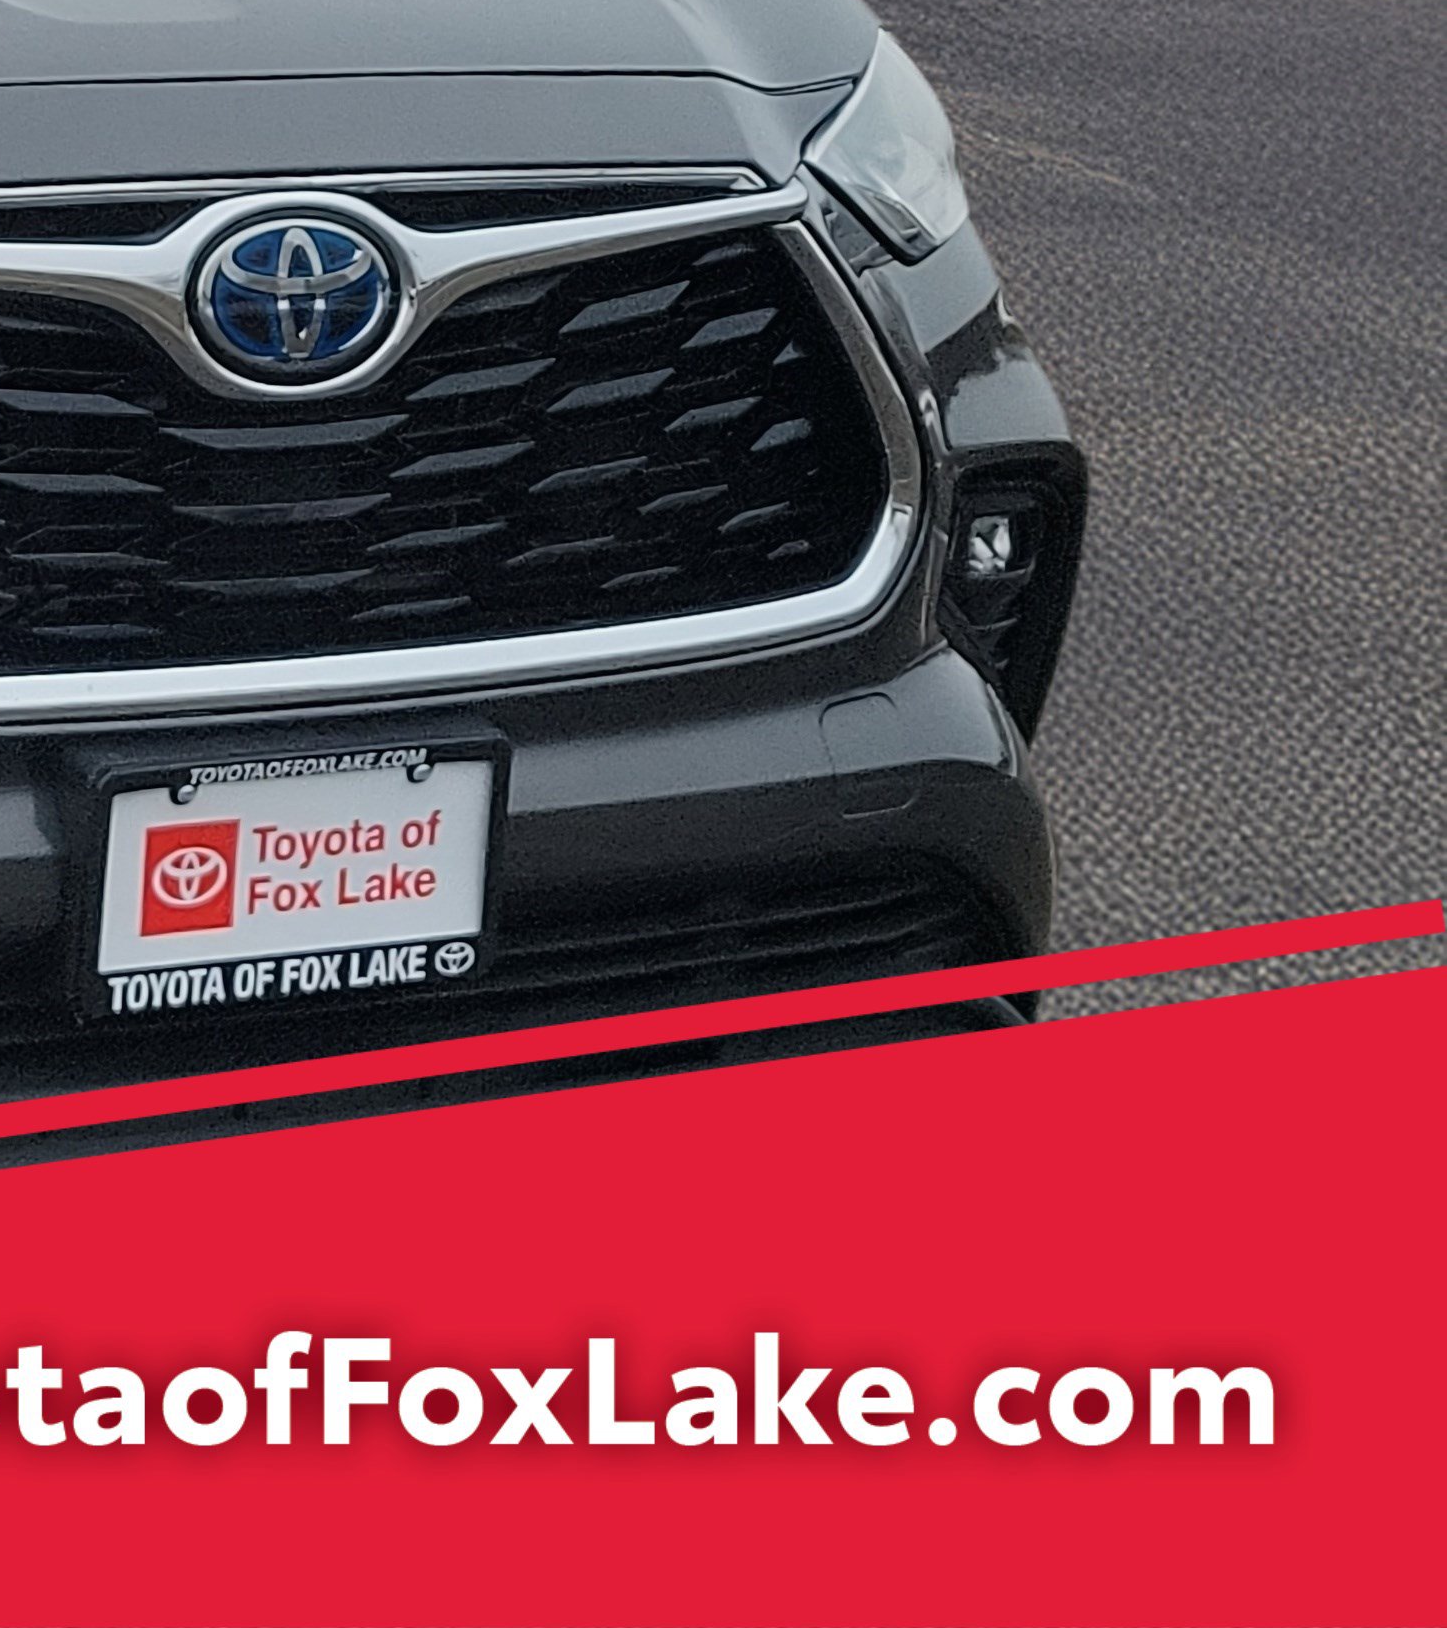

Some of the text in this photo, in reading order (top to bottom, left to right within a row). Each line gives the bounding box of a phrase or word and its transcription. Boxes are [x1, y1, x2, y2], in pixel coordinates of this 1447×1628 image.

[252, 809, 442, 869] Toyota of
[247, 863, 437, 915] Fox Lake
[107, 945, 427, 1014] TOYOTA OF FOX LAKE
